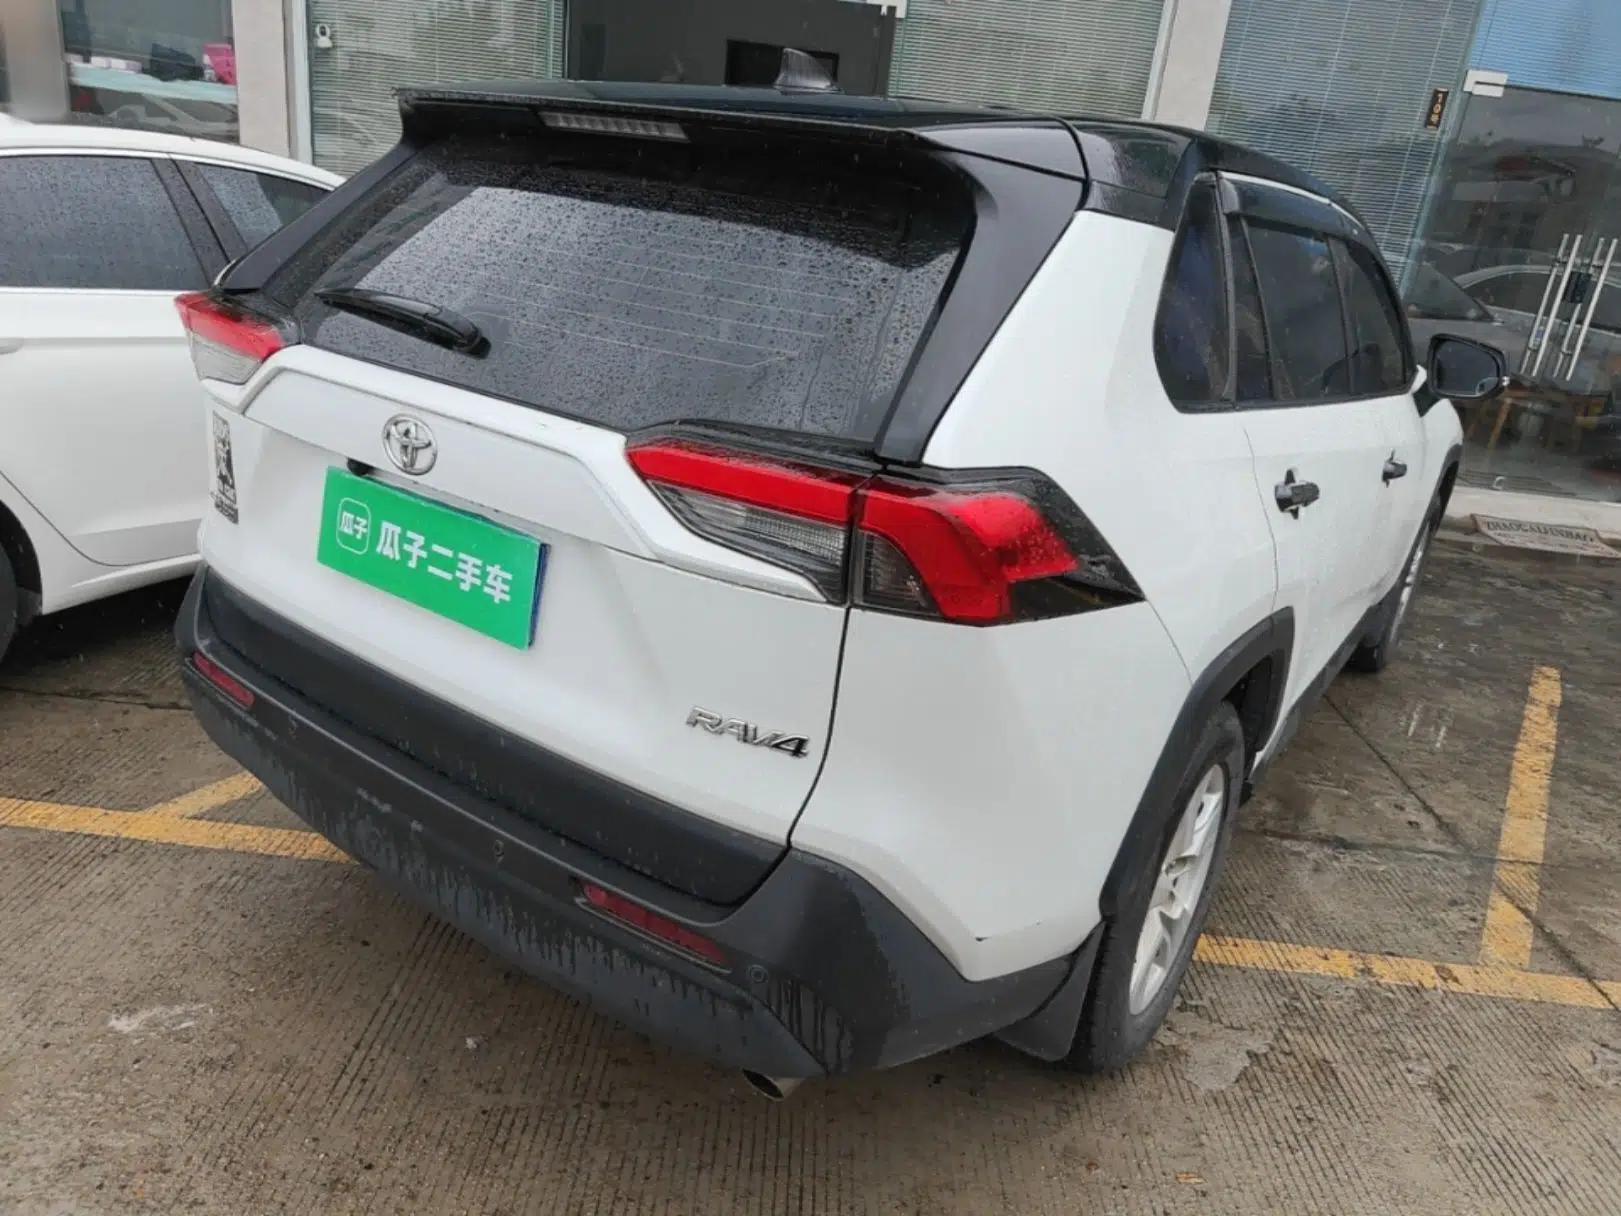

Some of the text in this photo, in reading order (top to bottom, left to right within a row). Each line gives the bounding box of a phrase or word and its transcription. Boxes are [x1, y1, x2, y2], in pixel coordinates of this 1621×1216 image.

[339, 511, 367, 540] 瓜子
[376, 520, 512, 604] 瓜子二手车
[686, 706, 809, 758] RAV4
